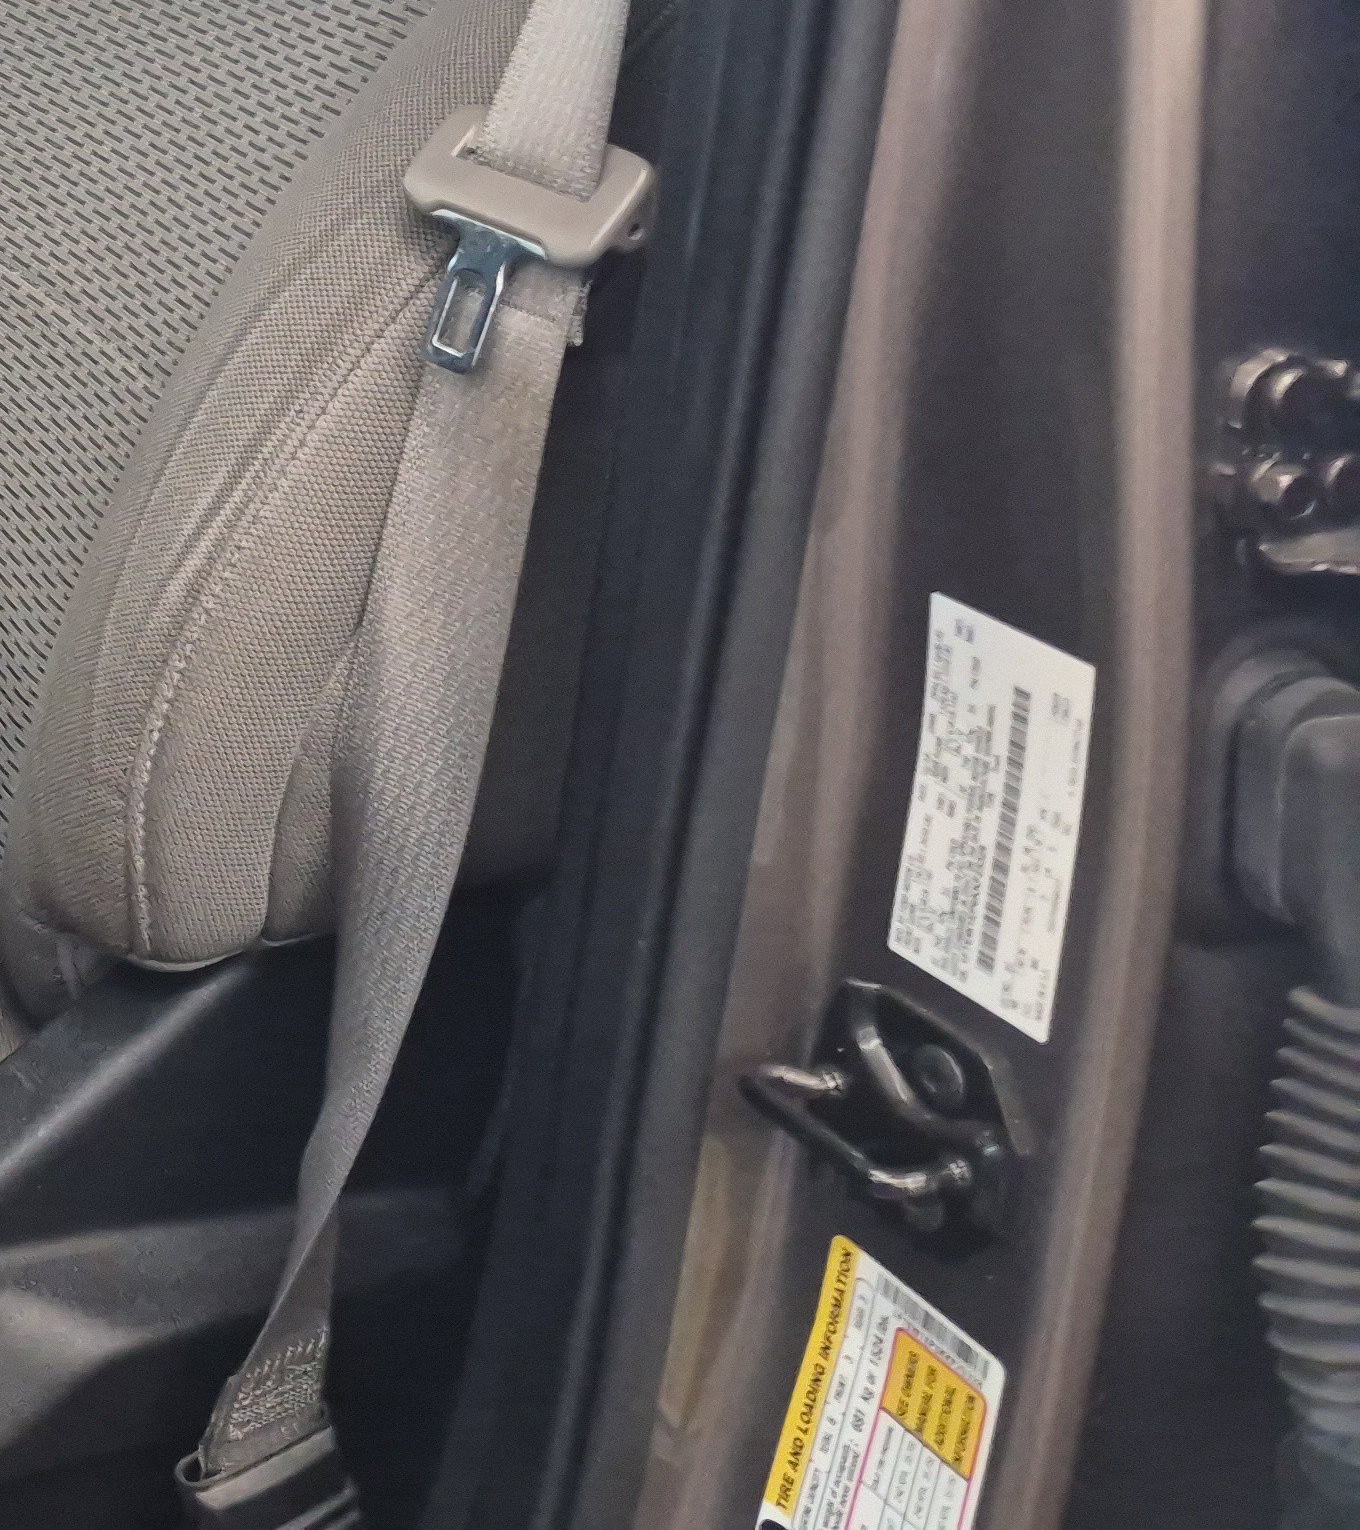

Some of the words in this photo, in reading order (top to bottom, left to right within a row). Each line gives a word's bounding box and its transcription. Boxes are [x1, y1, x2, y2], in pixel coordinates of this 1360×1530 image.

[775, 1472, 795, 1512] TIRE
[786, 1434, 805, 1473] AND
[797, 1362, 826, 1436] LOADING
[816, 1246, 854, 1362] INFORMATION
